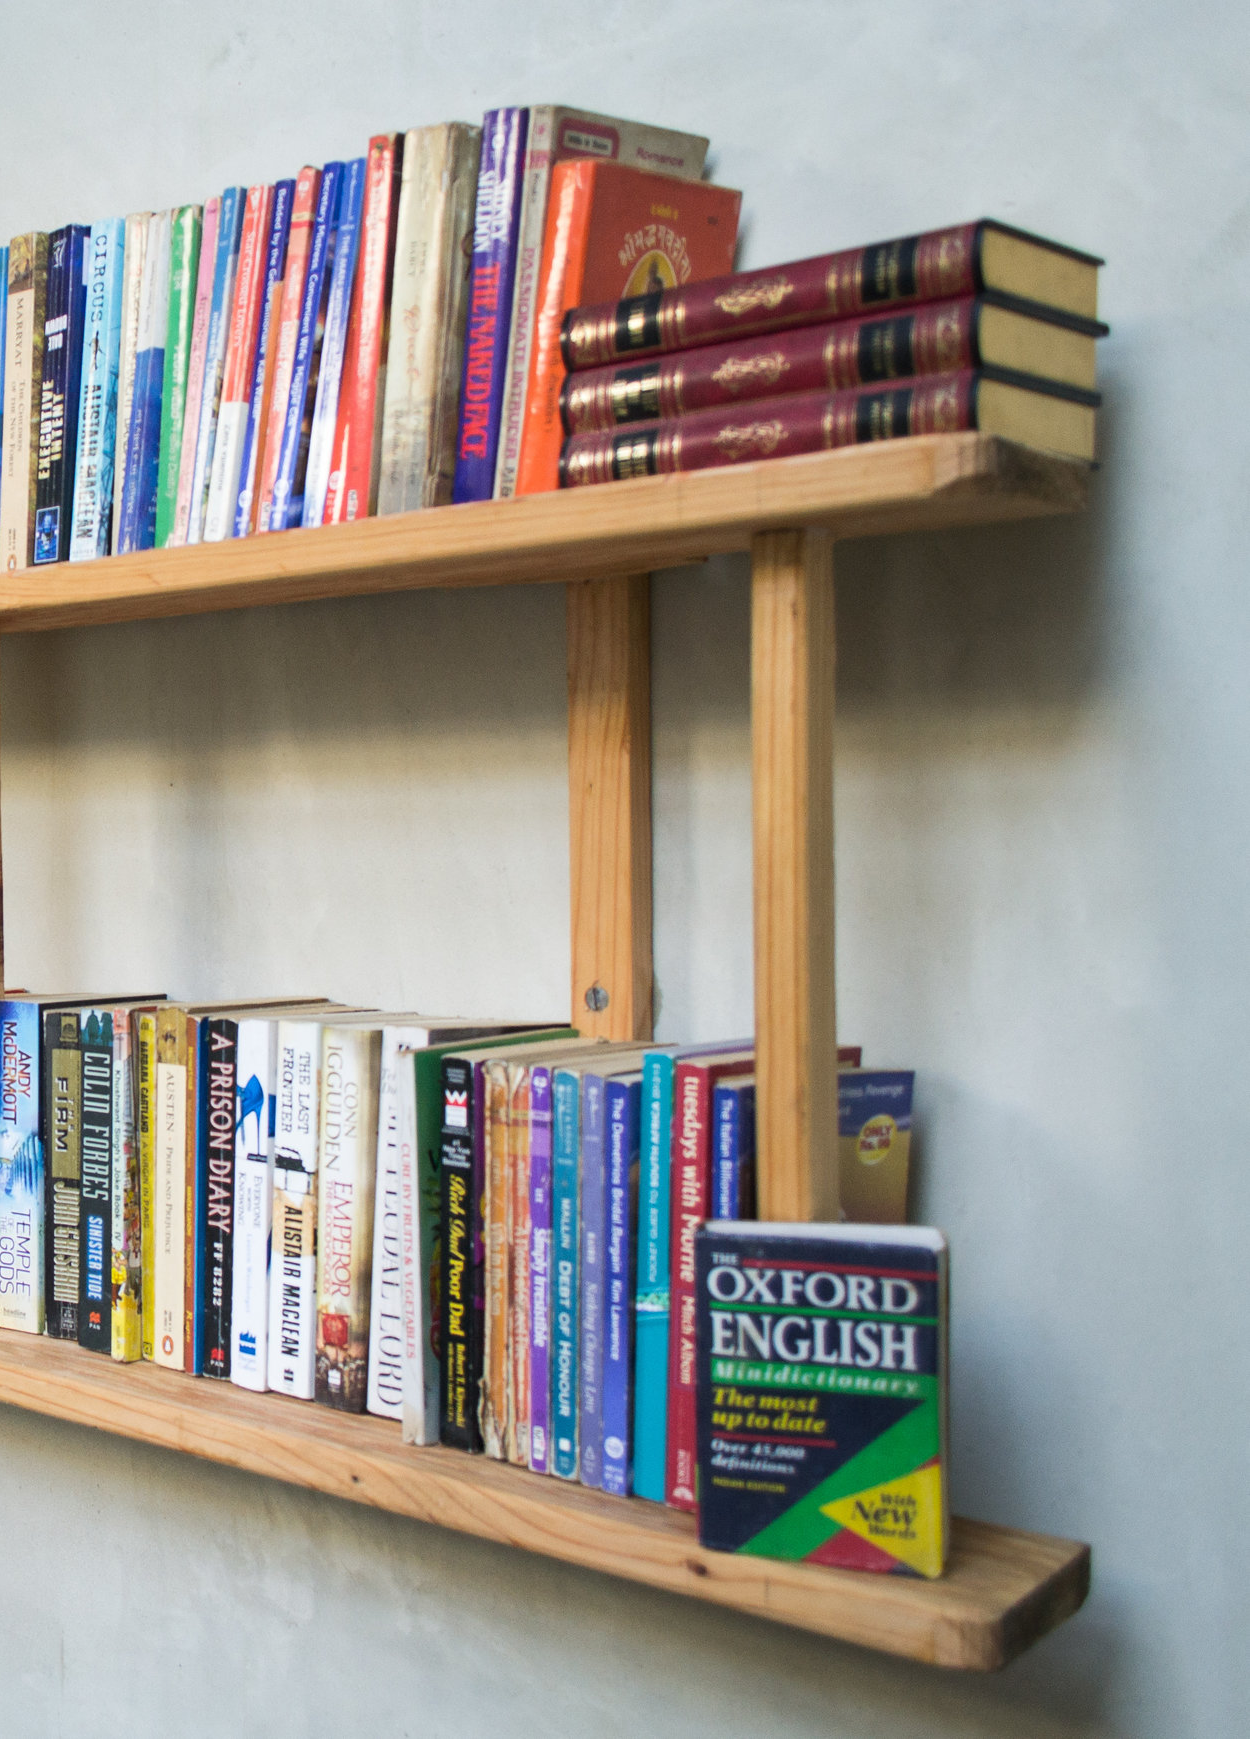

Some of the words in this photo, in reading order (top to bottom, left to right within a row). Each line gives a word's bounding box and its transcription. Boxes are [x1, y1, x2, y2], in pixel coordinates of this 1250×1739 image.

[90, 235, 107, 323] CIRCUS
[471, 262, 499, 314] THE
[14, 297, 24, 368] MARRYAT
[465, 316, 497, 402] NAKED
[38, 380, 54, 480] EXECUTIVE
[50, 393, 64, 462] INTENT
[460, 403, 490, 460] FACE
[211, 1033, 234, 1051] A
[299, 1051, 311, 1086] THE
[2, 1021, 17, 1125] McDERMOTT
[17, 1050, 32, 1098] ANDY
[83, 1051, 111, 1114] COLIN
[281, 1047, 295, 1134] FRONTIER
[54, 1077, 69, 1153] FIRM
[209, 1061, 234, 1150] PRISON
[297, 1093, 310, 1134] LAST
[324, 1045, 343, 1172] IGGULDEN
[343, 1082, 358, 1139] CONN
[681, 1076, 699, 1160] Tuesdays
[82, 1124, 110, 1202] FORBES
[681, 1166, 696, 1209] with
[53, 1181, 80, 1227] JOHN
[207, 1158, 232, 1233] DIARY
[450, 1174, 466, 1215] Rich
[11, 1209, 31, 1297] TEMPLE
[53, 1227, 80, 1304] GRISHAM
[88, 1215, 103, 1270] SINISTER
[283, 1205, 304, 1277] ALISTAIR
[331, 1180, 353, 1297] EMPEROR
[711, 1251, 739, 1266] THE
[87, 1273, 102, 1301] TIDE
[557, 1260, 572, 1306] DEBT
[707, 1266, 919, 1315] OXFORD
[280, 1283, 301, 1358] MACLEAN
[449, 1303, 465, 1336] Dad
[558, 1312, 571, 1336] OF
[709, 1310, 918, 1371] ENGLISH
[376, 1312, 403, 1406] LORD
[558, 1340, 571, 1417] HONOUR
[714, 1361, 920, 1395] Minidictionary
[711, 1411, 743, 1432] up
[746, 1412, 769, 1429] to
[773, 1412, 826, 1433] date
[713, 1387, 755, 1409] The
[758, 1394, 818, 1413] most
[710, 1438, 749, 1453] Over
[752, 1439, 807, 1460] 45,000
[711, 1454, 797, 1475] definitions
[853, 1499, 918, 1525] New
[880, 1493, 917, 1508] With
[869, 1525, 917, 1540] Words
